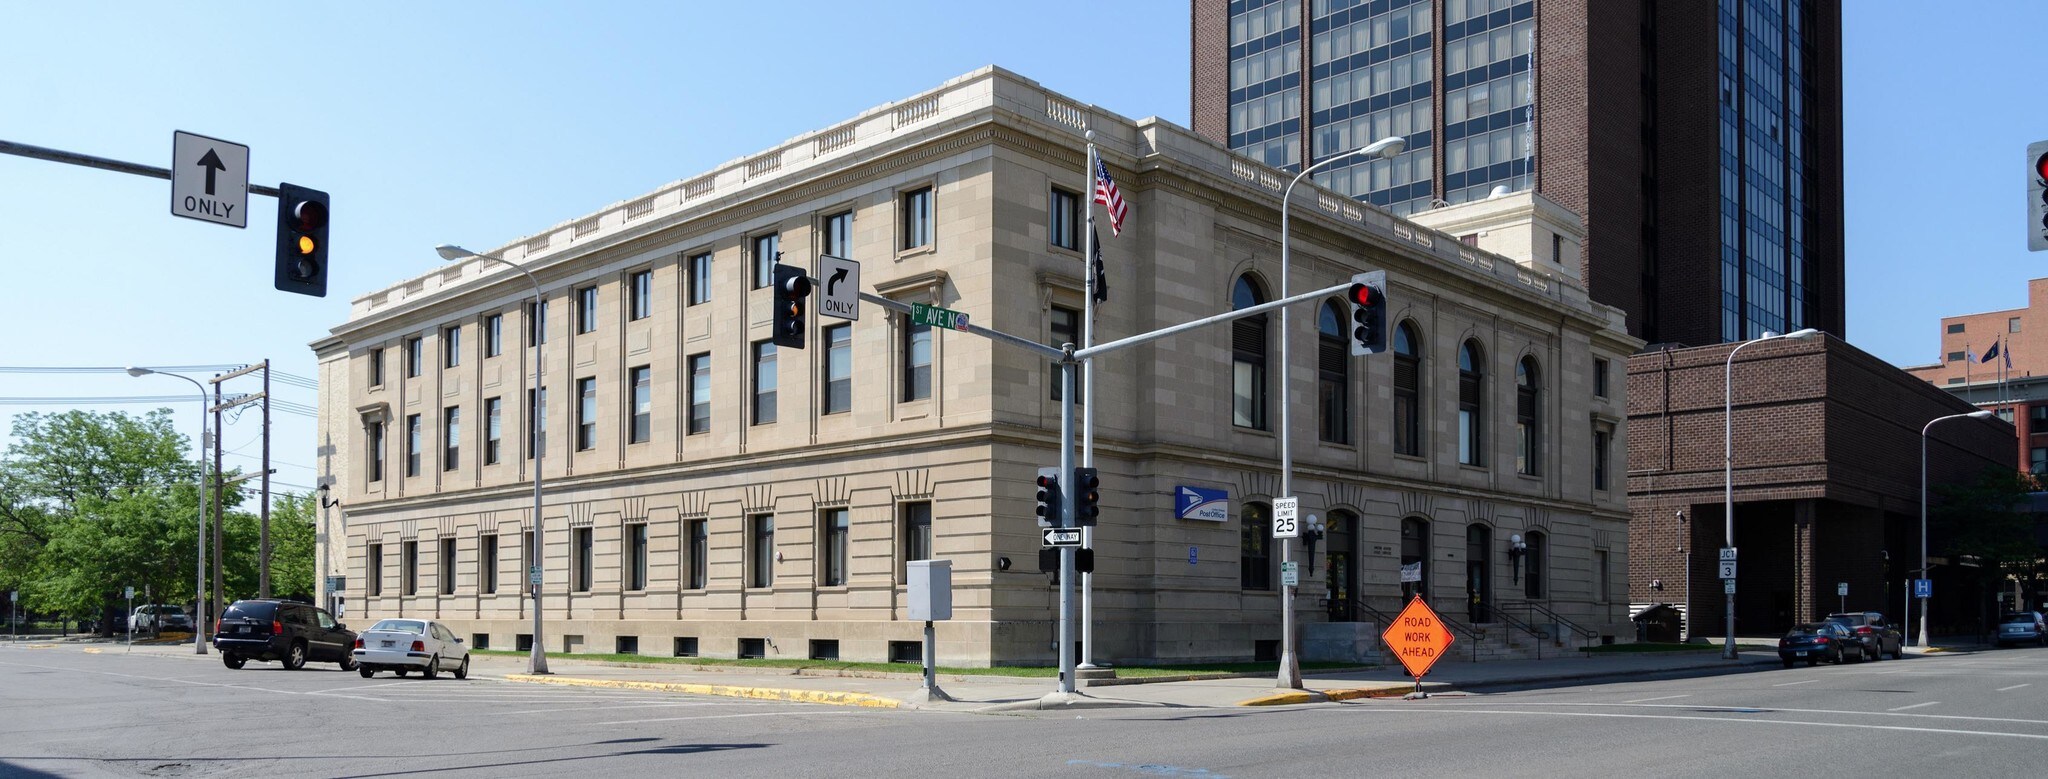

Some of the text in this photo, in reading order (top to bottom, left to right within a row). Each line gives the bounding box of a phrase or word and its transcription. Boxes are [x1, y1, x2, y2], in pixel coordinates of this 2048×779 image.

[185, 196, 234, 218] ONLY
[825, 299, 854, 315] ONLY
[926, 308, 944, 326] AVE
[947, 312, 955, 328] N
[1199, 509, 1225, 519] Post Office
[1276, 518, 1295, 532] 25
[1725, 567, 1731, 576] 3
[1918, 581, 1928, 592] H
[1404, 617, 1431, 627] ROAD
[1404, 632, 1431, 642] WORK
[1402, 647, 1434, 657] AHEAD
